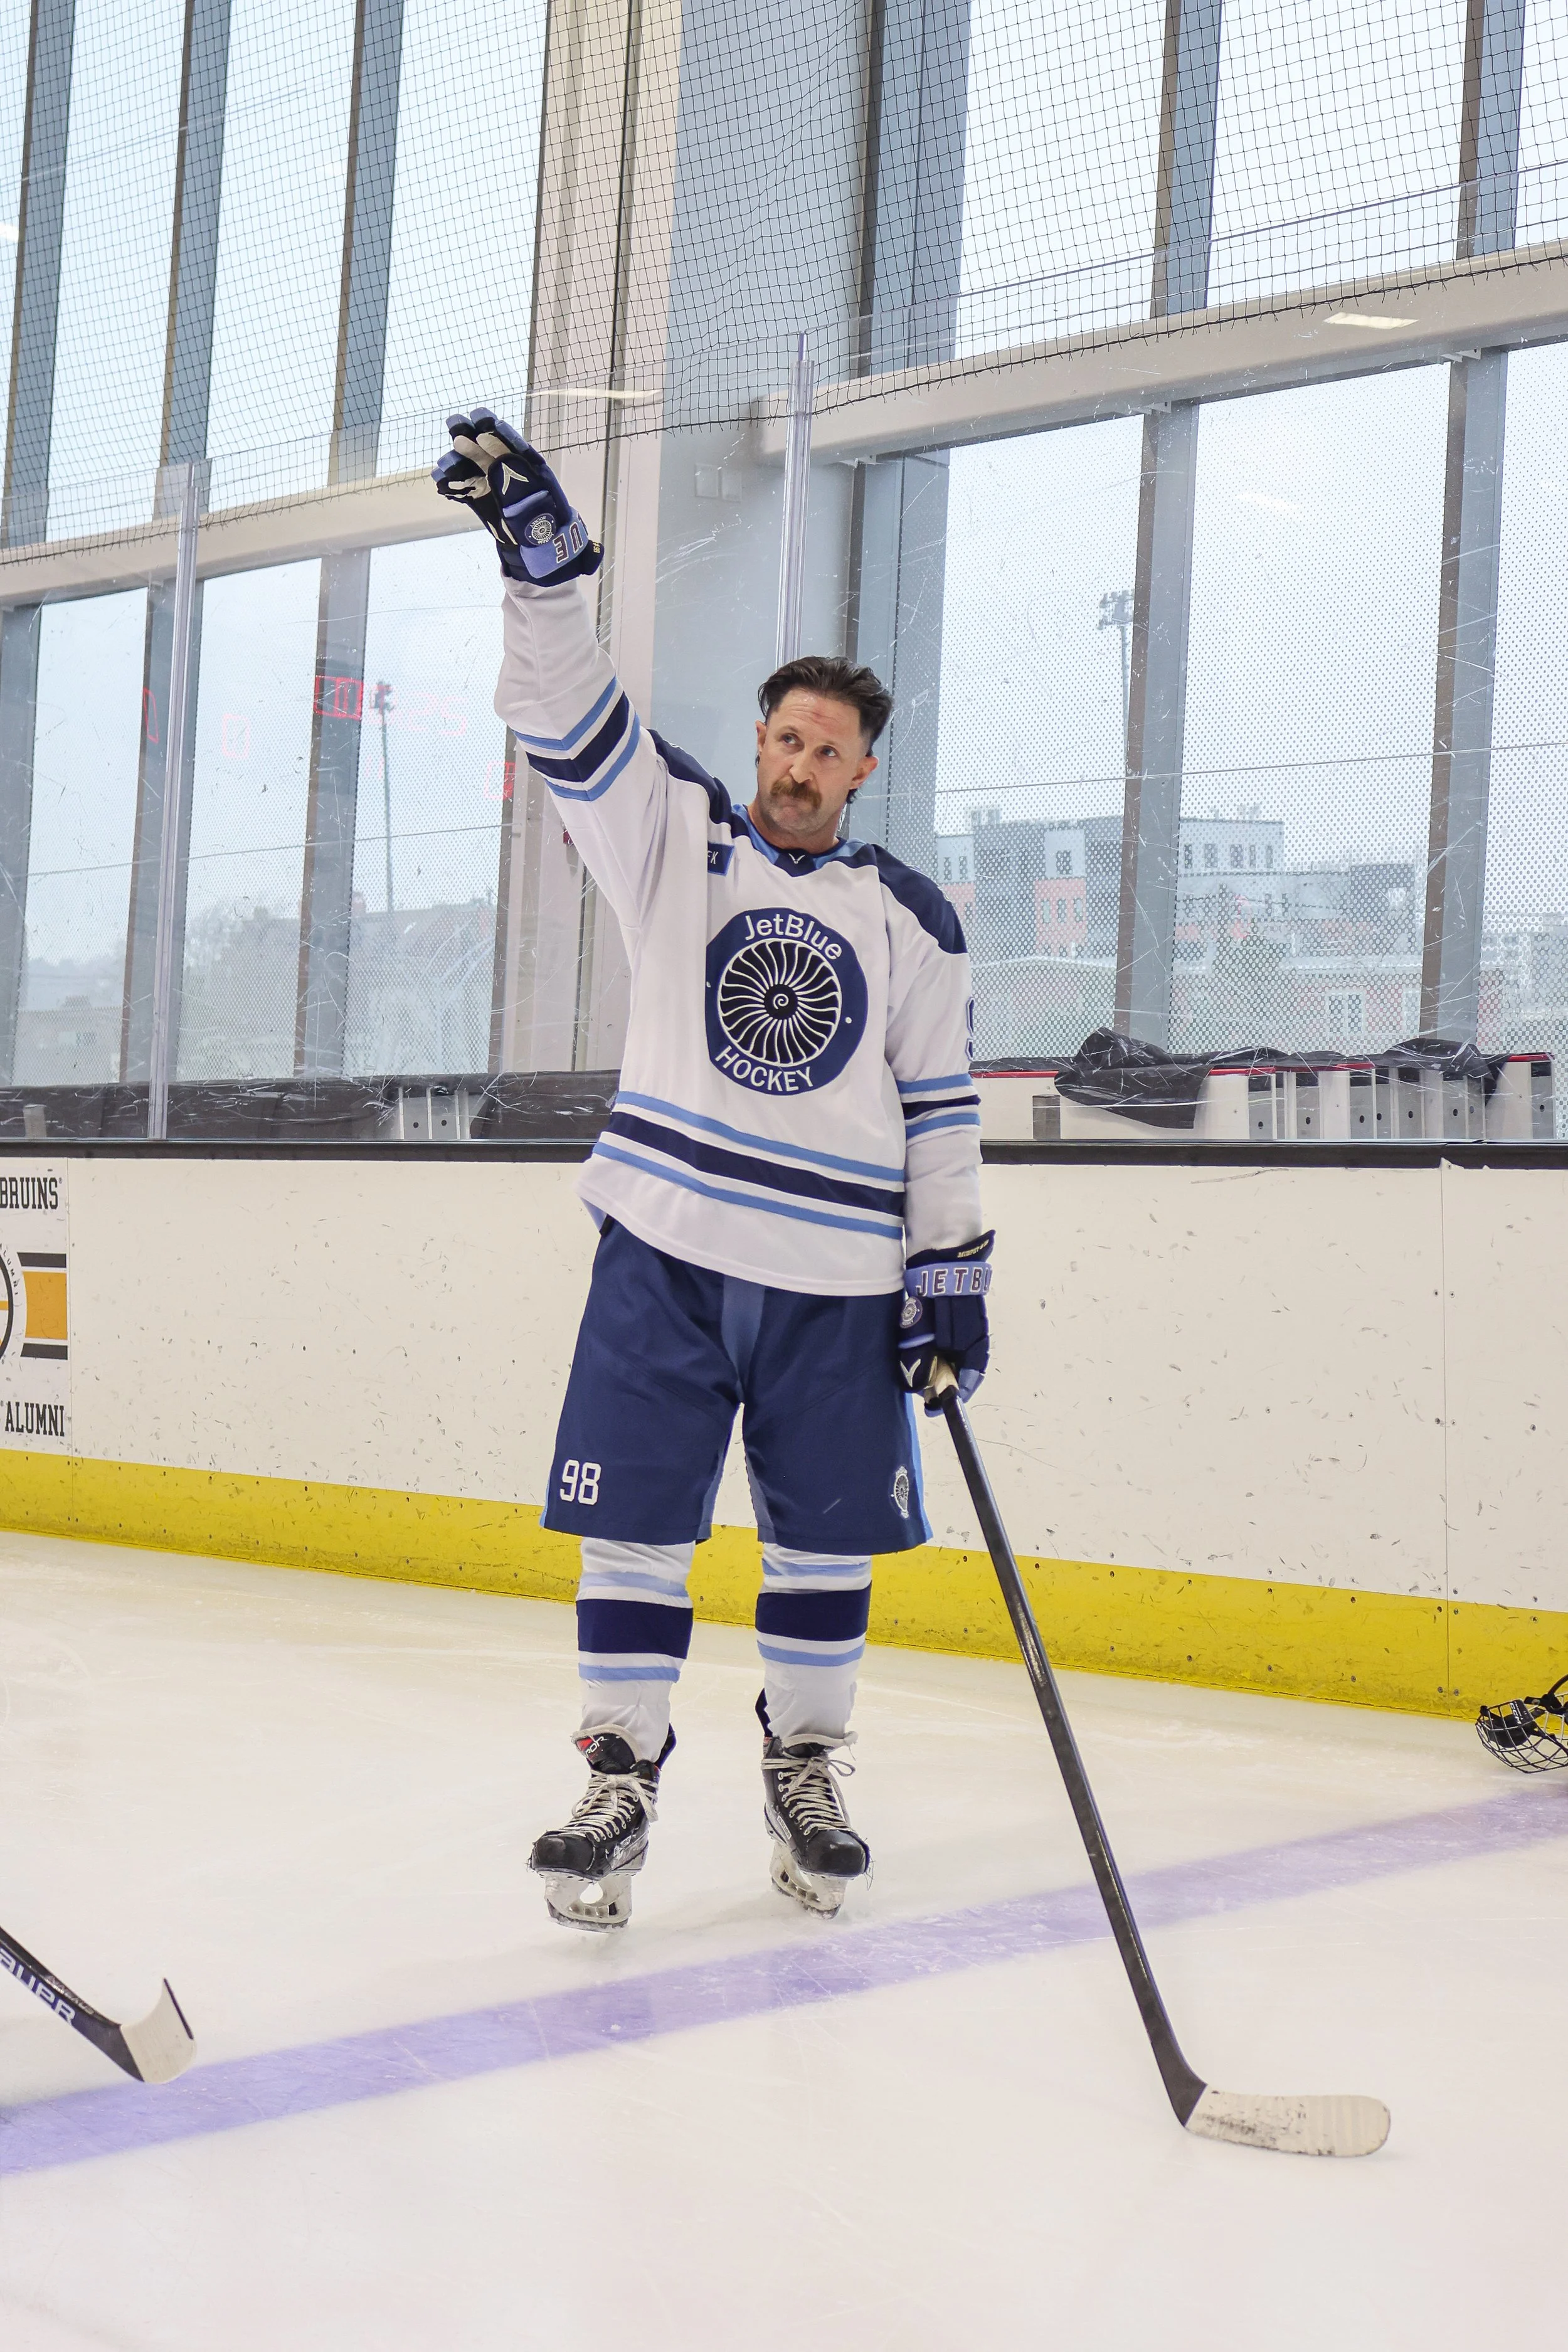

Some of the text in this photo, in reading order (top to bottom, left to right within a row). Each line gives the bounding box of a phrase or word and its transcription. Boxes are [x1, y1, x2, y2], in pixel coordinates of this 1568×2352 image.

[745, 914, 842, 960] JetBlue
[715, 1045, 813, 1092] HOCKEY
[5, 1401, 65, 1437] ALUMNI
[559, 1459, 602, 1505] 98
[1510, 1702, 1522, 1724] CCM
